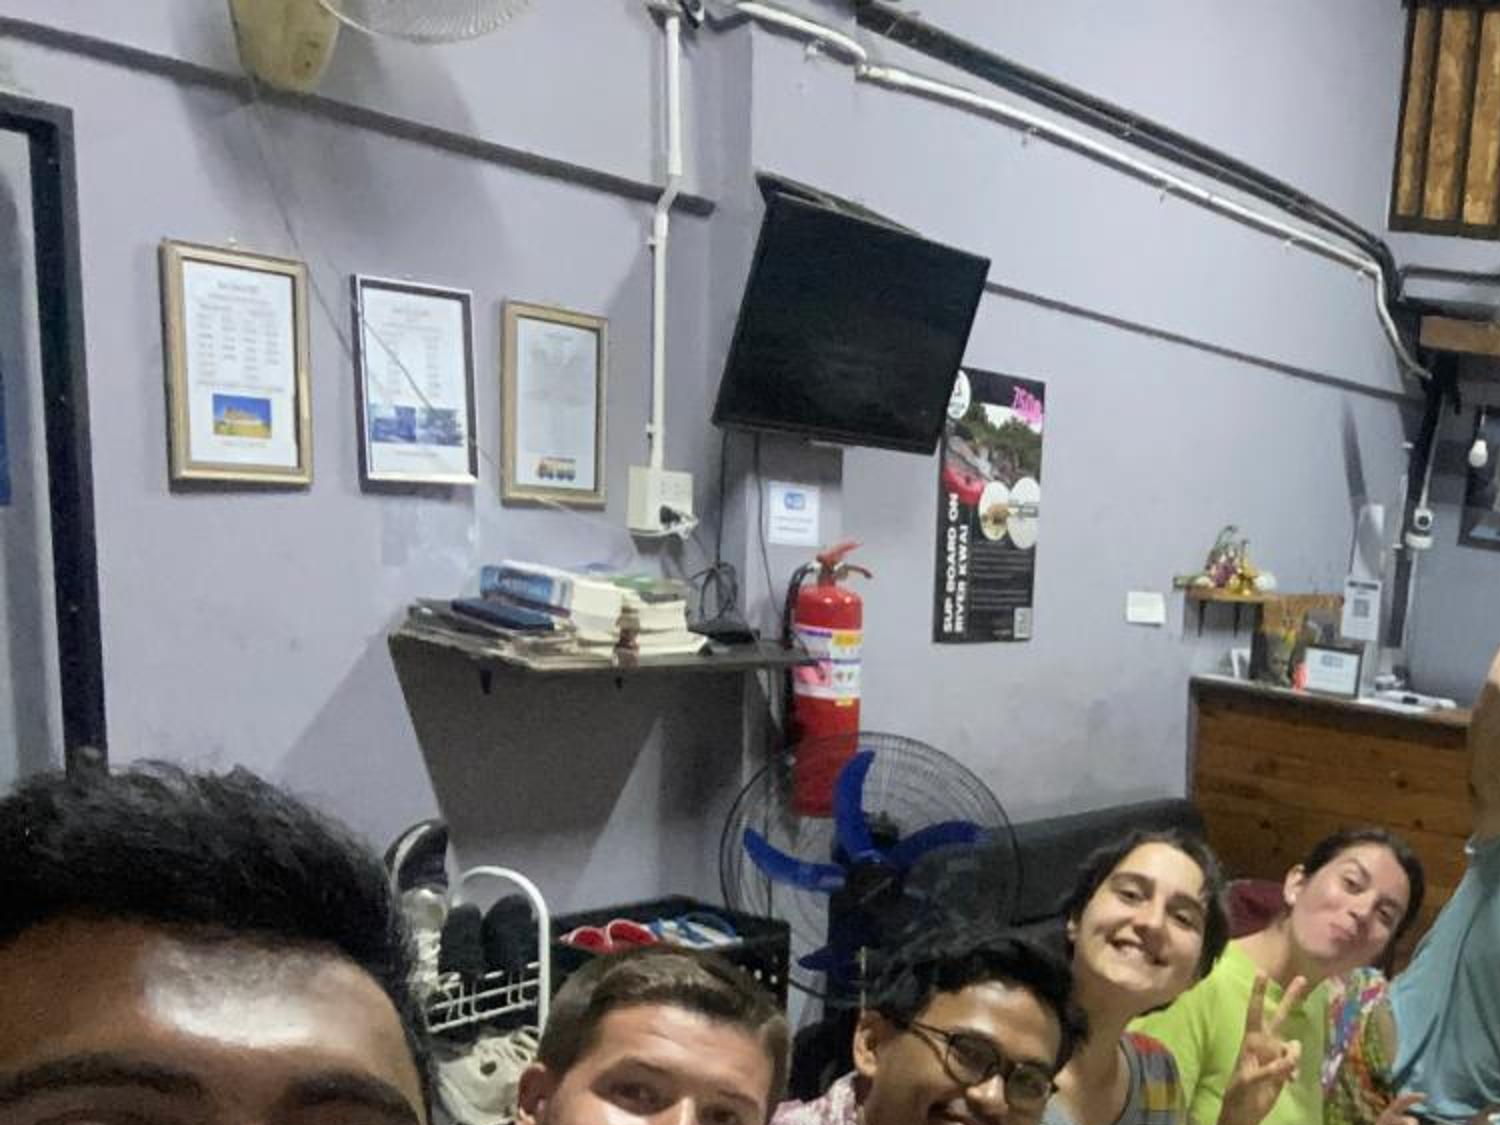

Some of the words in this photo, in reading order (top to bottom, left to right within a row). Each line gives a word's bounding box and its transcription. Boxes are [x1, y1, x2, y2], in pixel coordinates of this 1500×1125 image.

[948, 493, 959, 521] ON
[946, 527, 958, 593] BOARD
[958, 524, 969, 575] KWAI
[943, 597, 953, 632] SUP
[954, 581, 967, 633] RIVER
